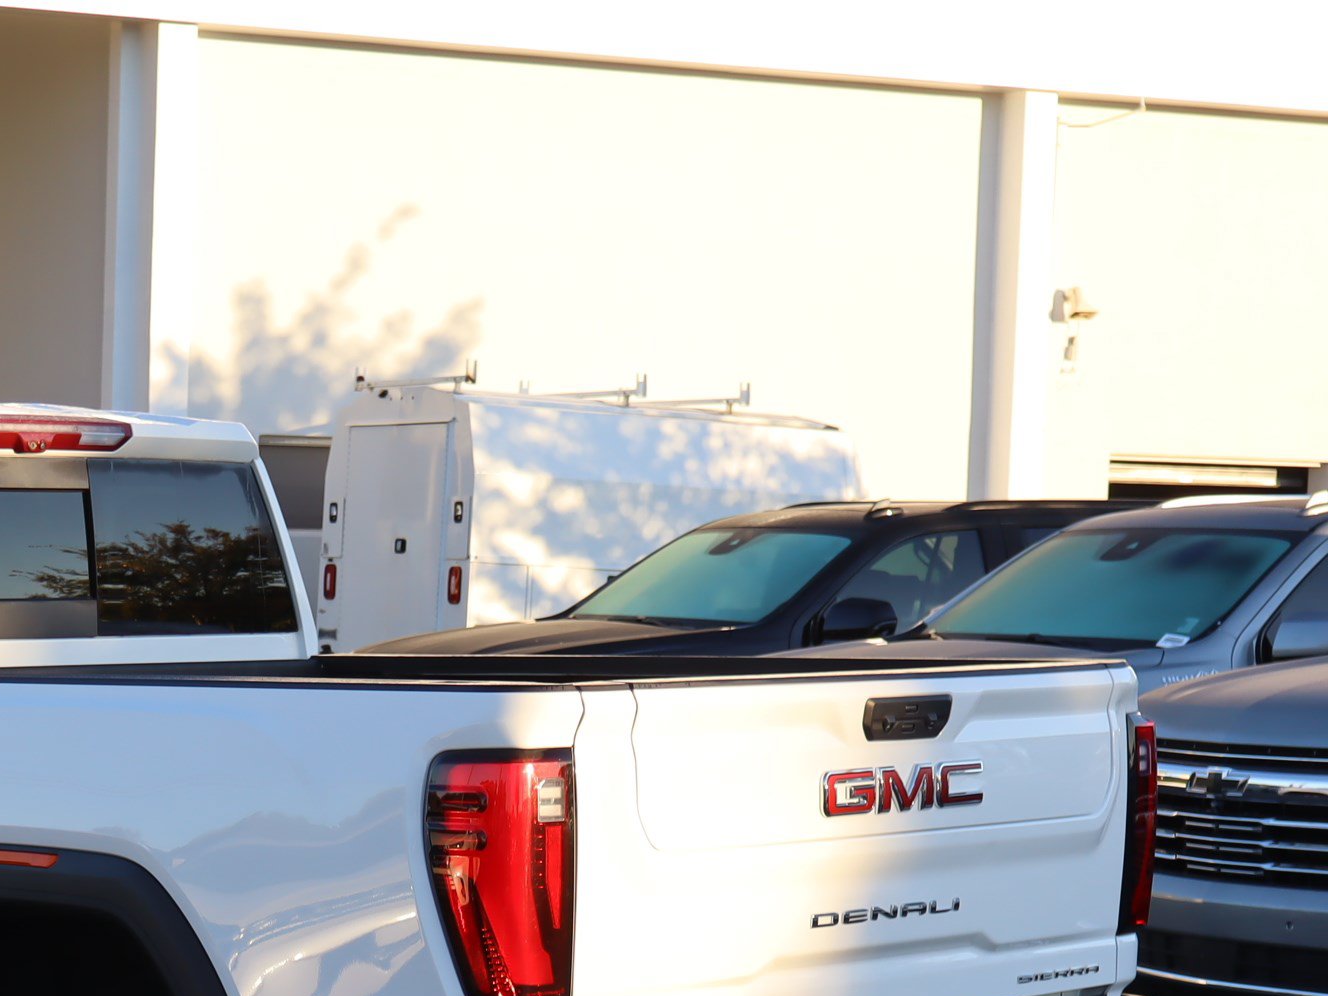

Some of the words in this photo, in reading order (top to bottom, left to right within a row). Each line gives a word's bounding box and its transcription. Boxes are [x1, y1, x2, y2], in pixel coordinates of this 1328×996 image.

[821, 759, 984, 817] GMC
[810, 898, 961, 928] DENALI
[1017, 965, 1100, 984] SIERRA
